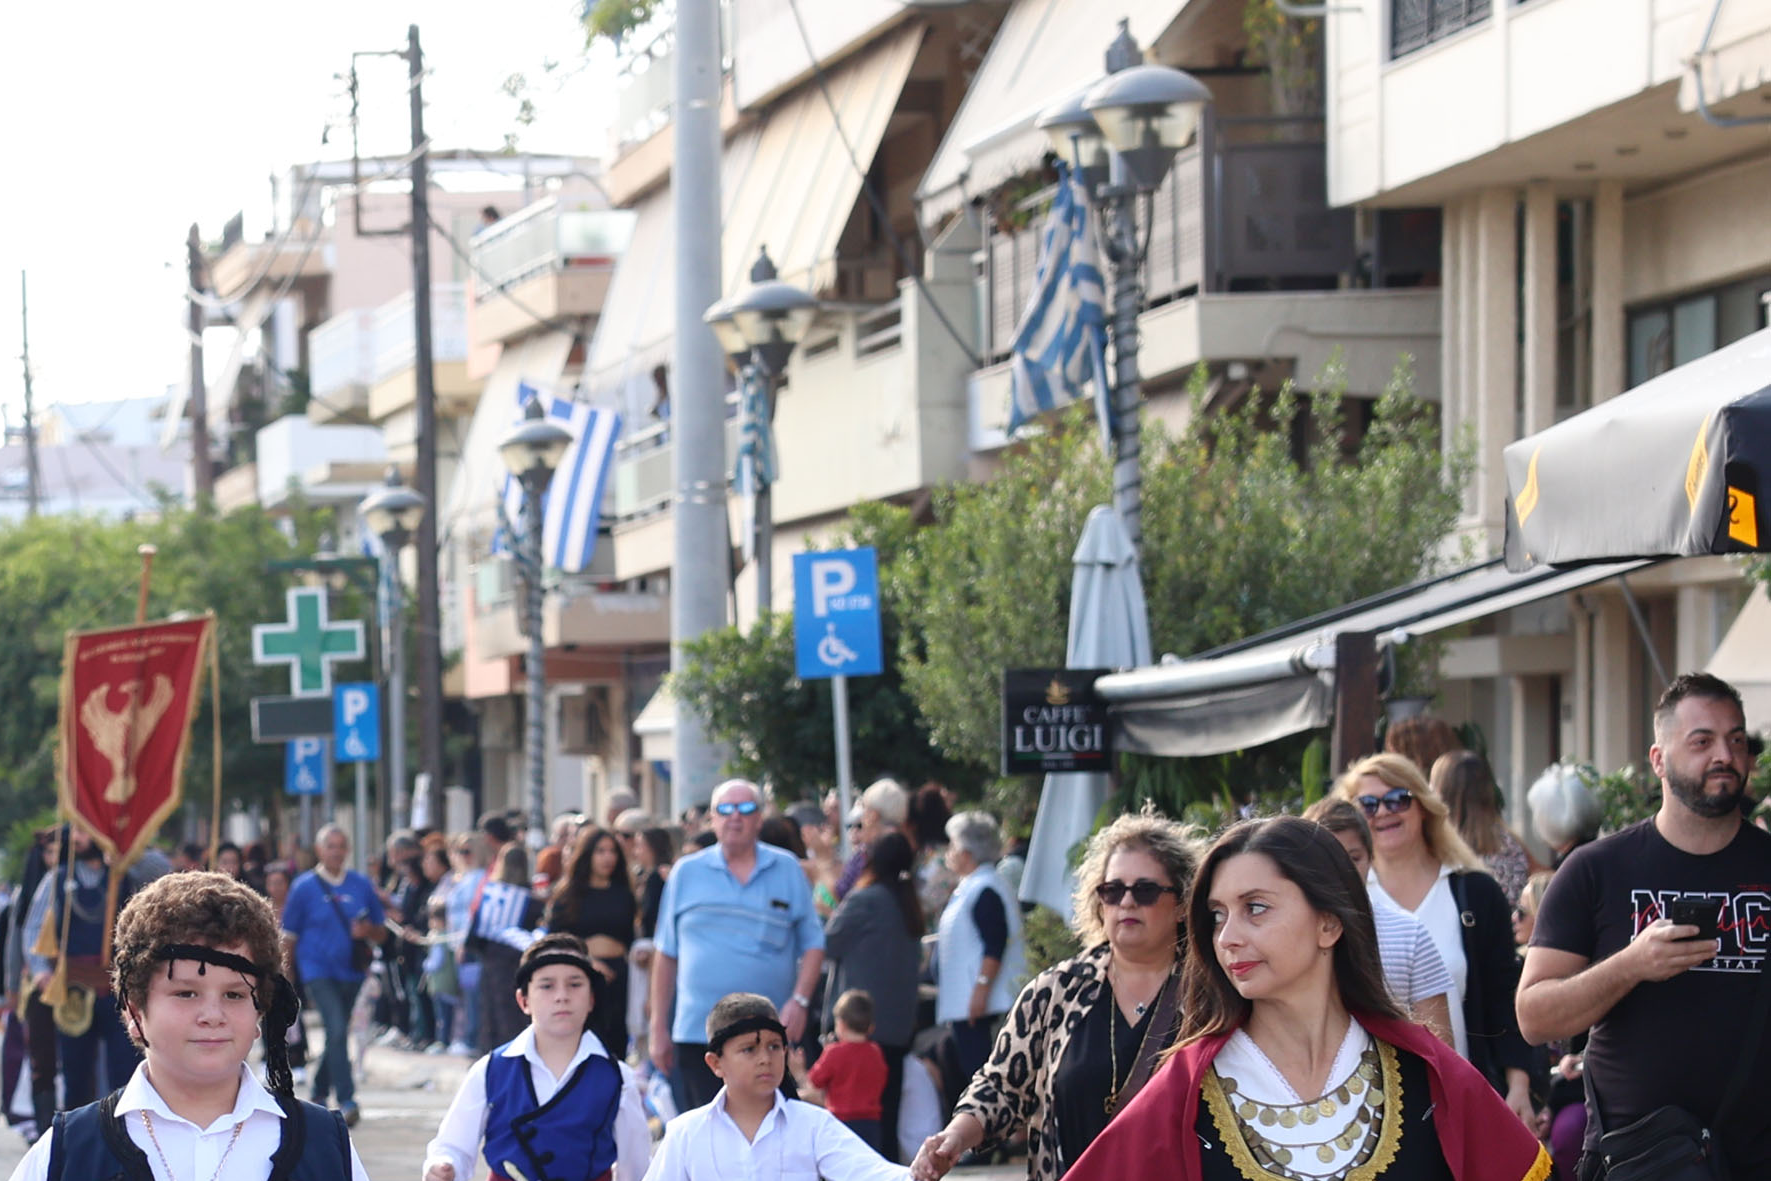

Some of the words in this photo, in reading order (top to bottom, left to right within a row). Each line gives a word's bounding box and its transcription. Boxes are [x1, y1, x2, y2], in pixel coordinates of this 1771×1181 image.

[811, 559, 857, 617] P
[343, 689, 369, 726] P
[294, 736, 320, 765] P
[1014, 724, 1103, 752] LUIGI
